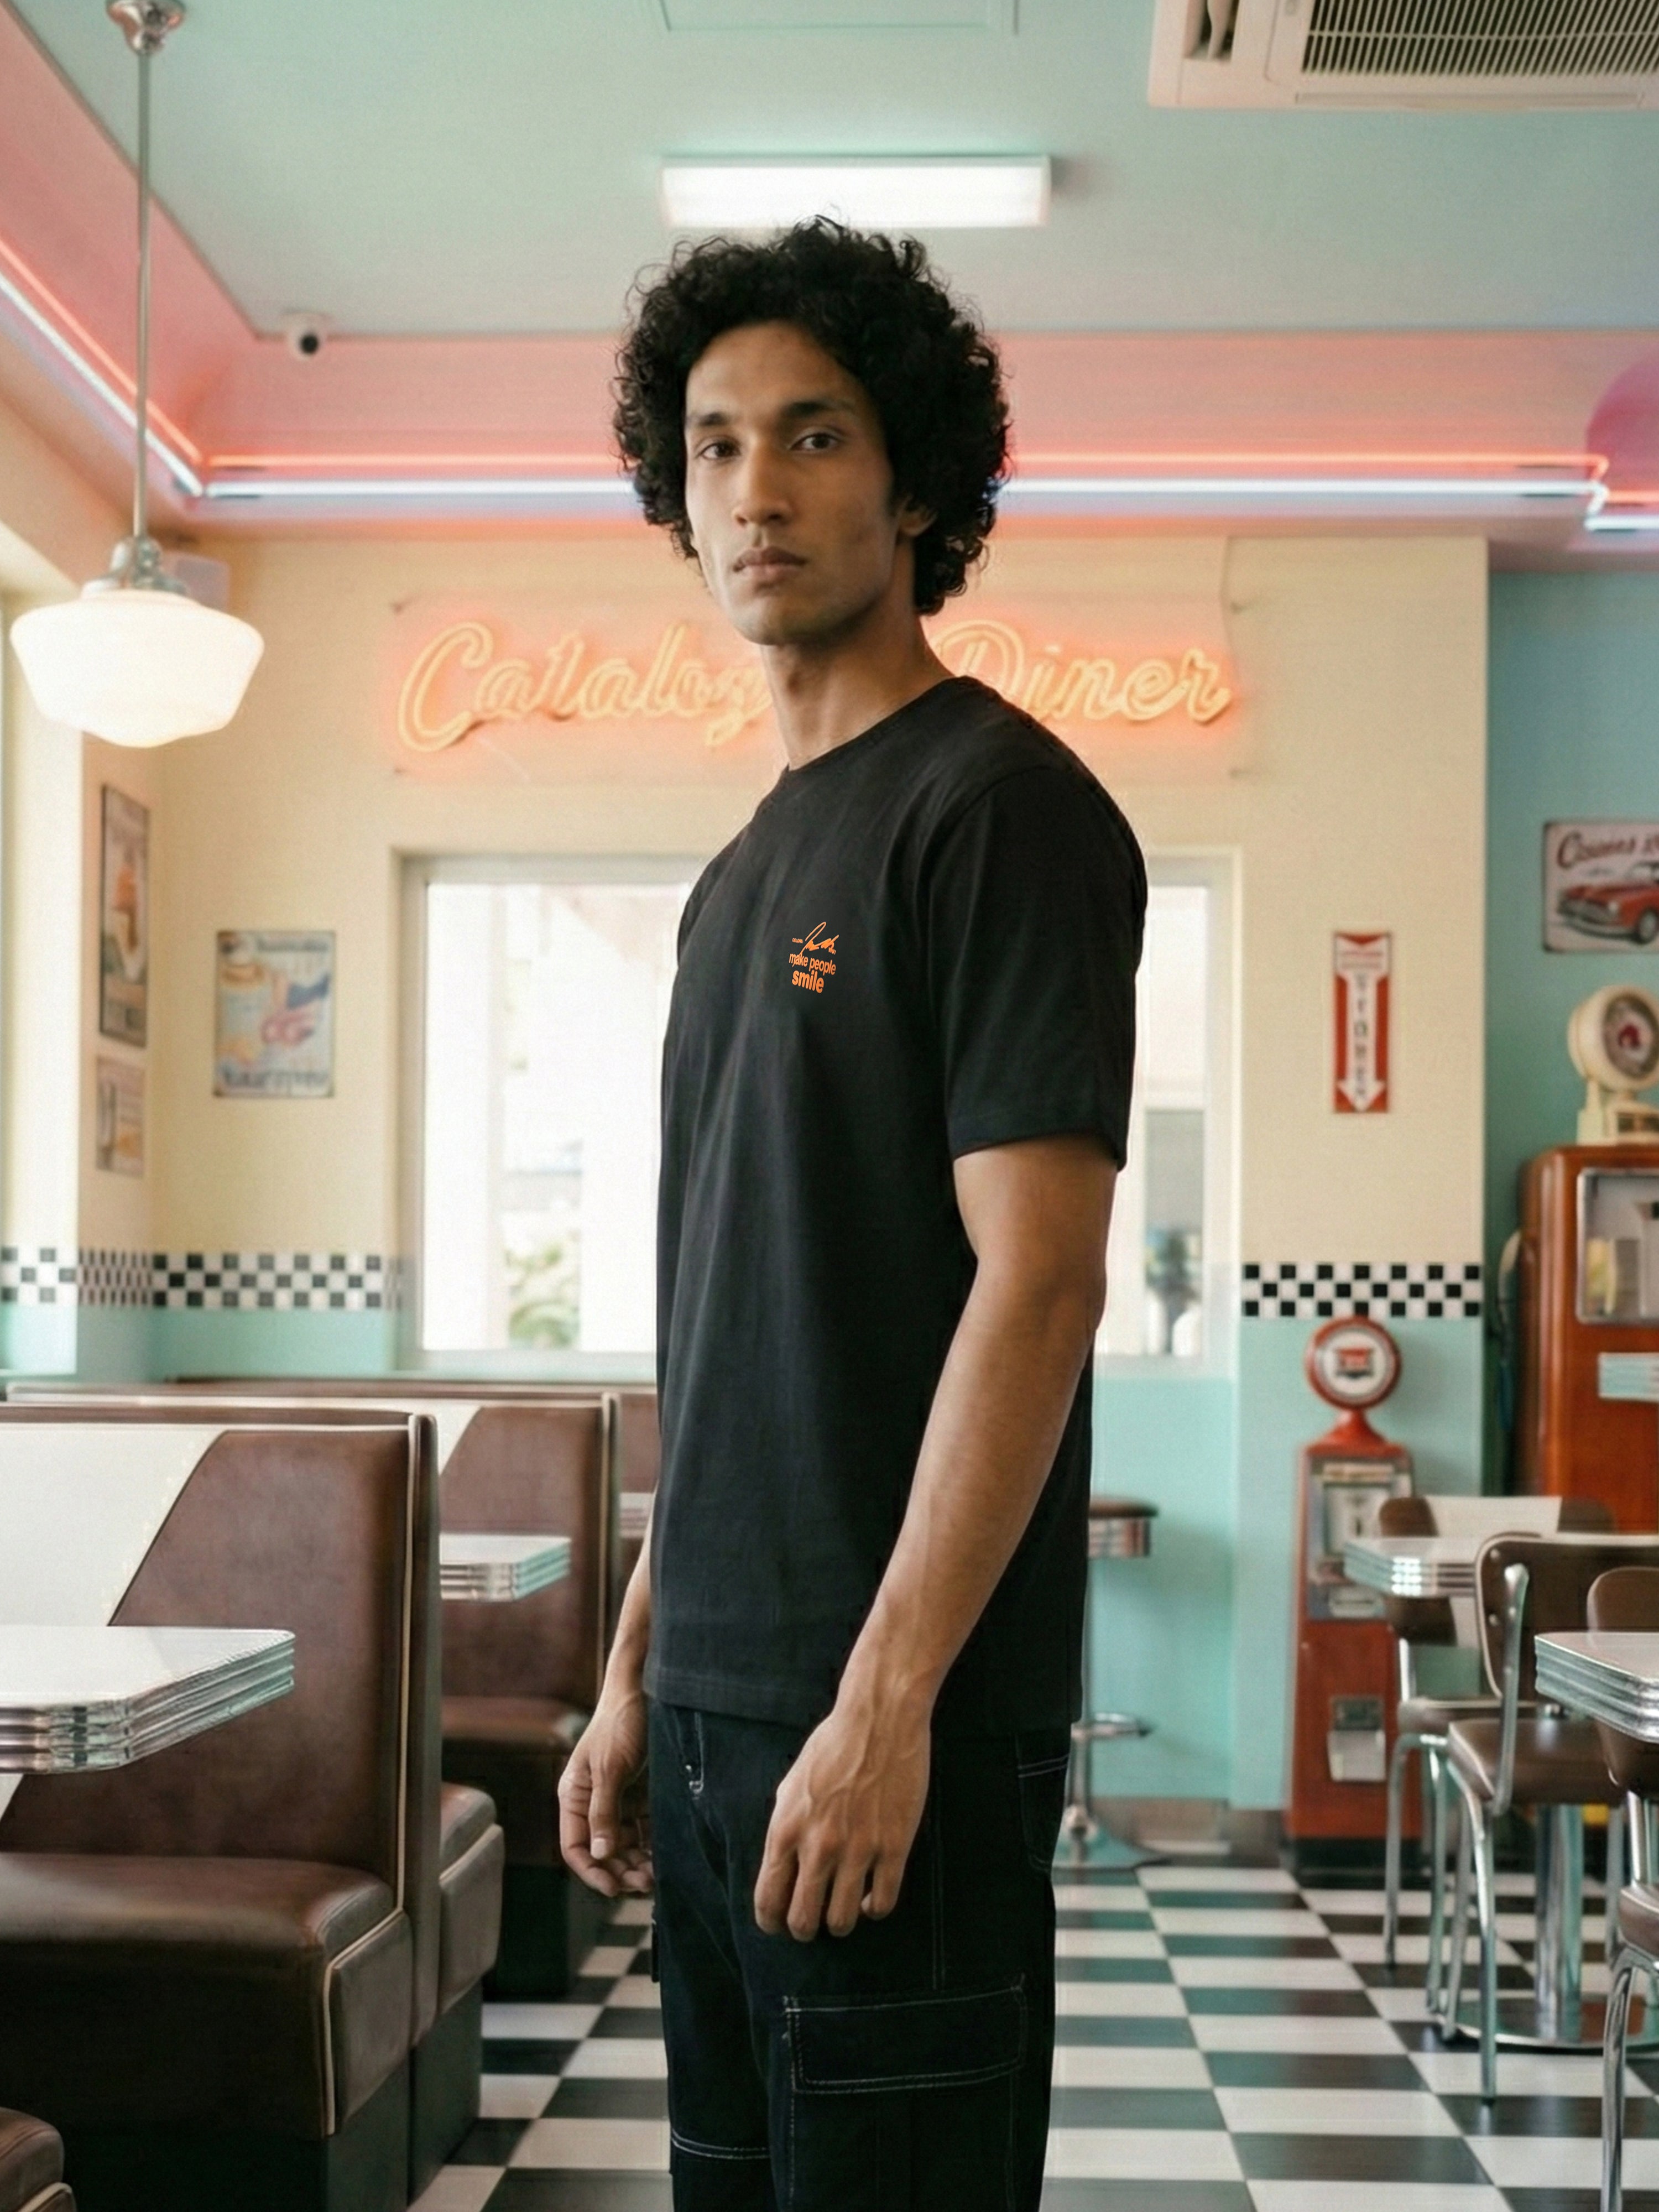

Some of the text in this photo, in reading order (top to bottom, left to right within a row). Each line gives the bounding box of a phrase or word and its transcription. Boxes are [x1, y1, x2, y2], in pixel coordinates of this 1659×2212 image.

[397, 619, 1232, 752] Catalog Diner
[789, 952, 836, 976] make people
[792, 970, 824, 994] smile
